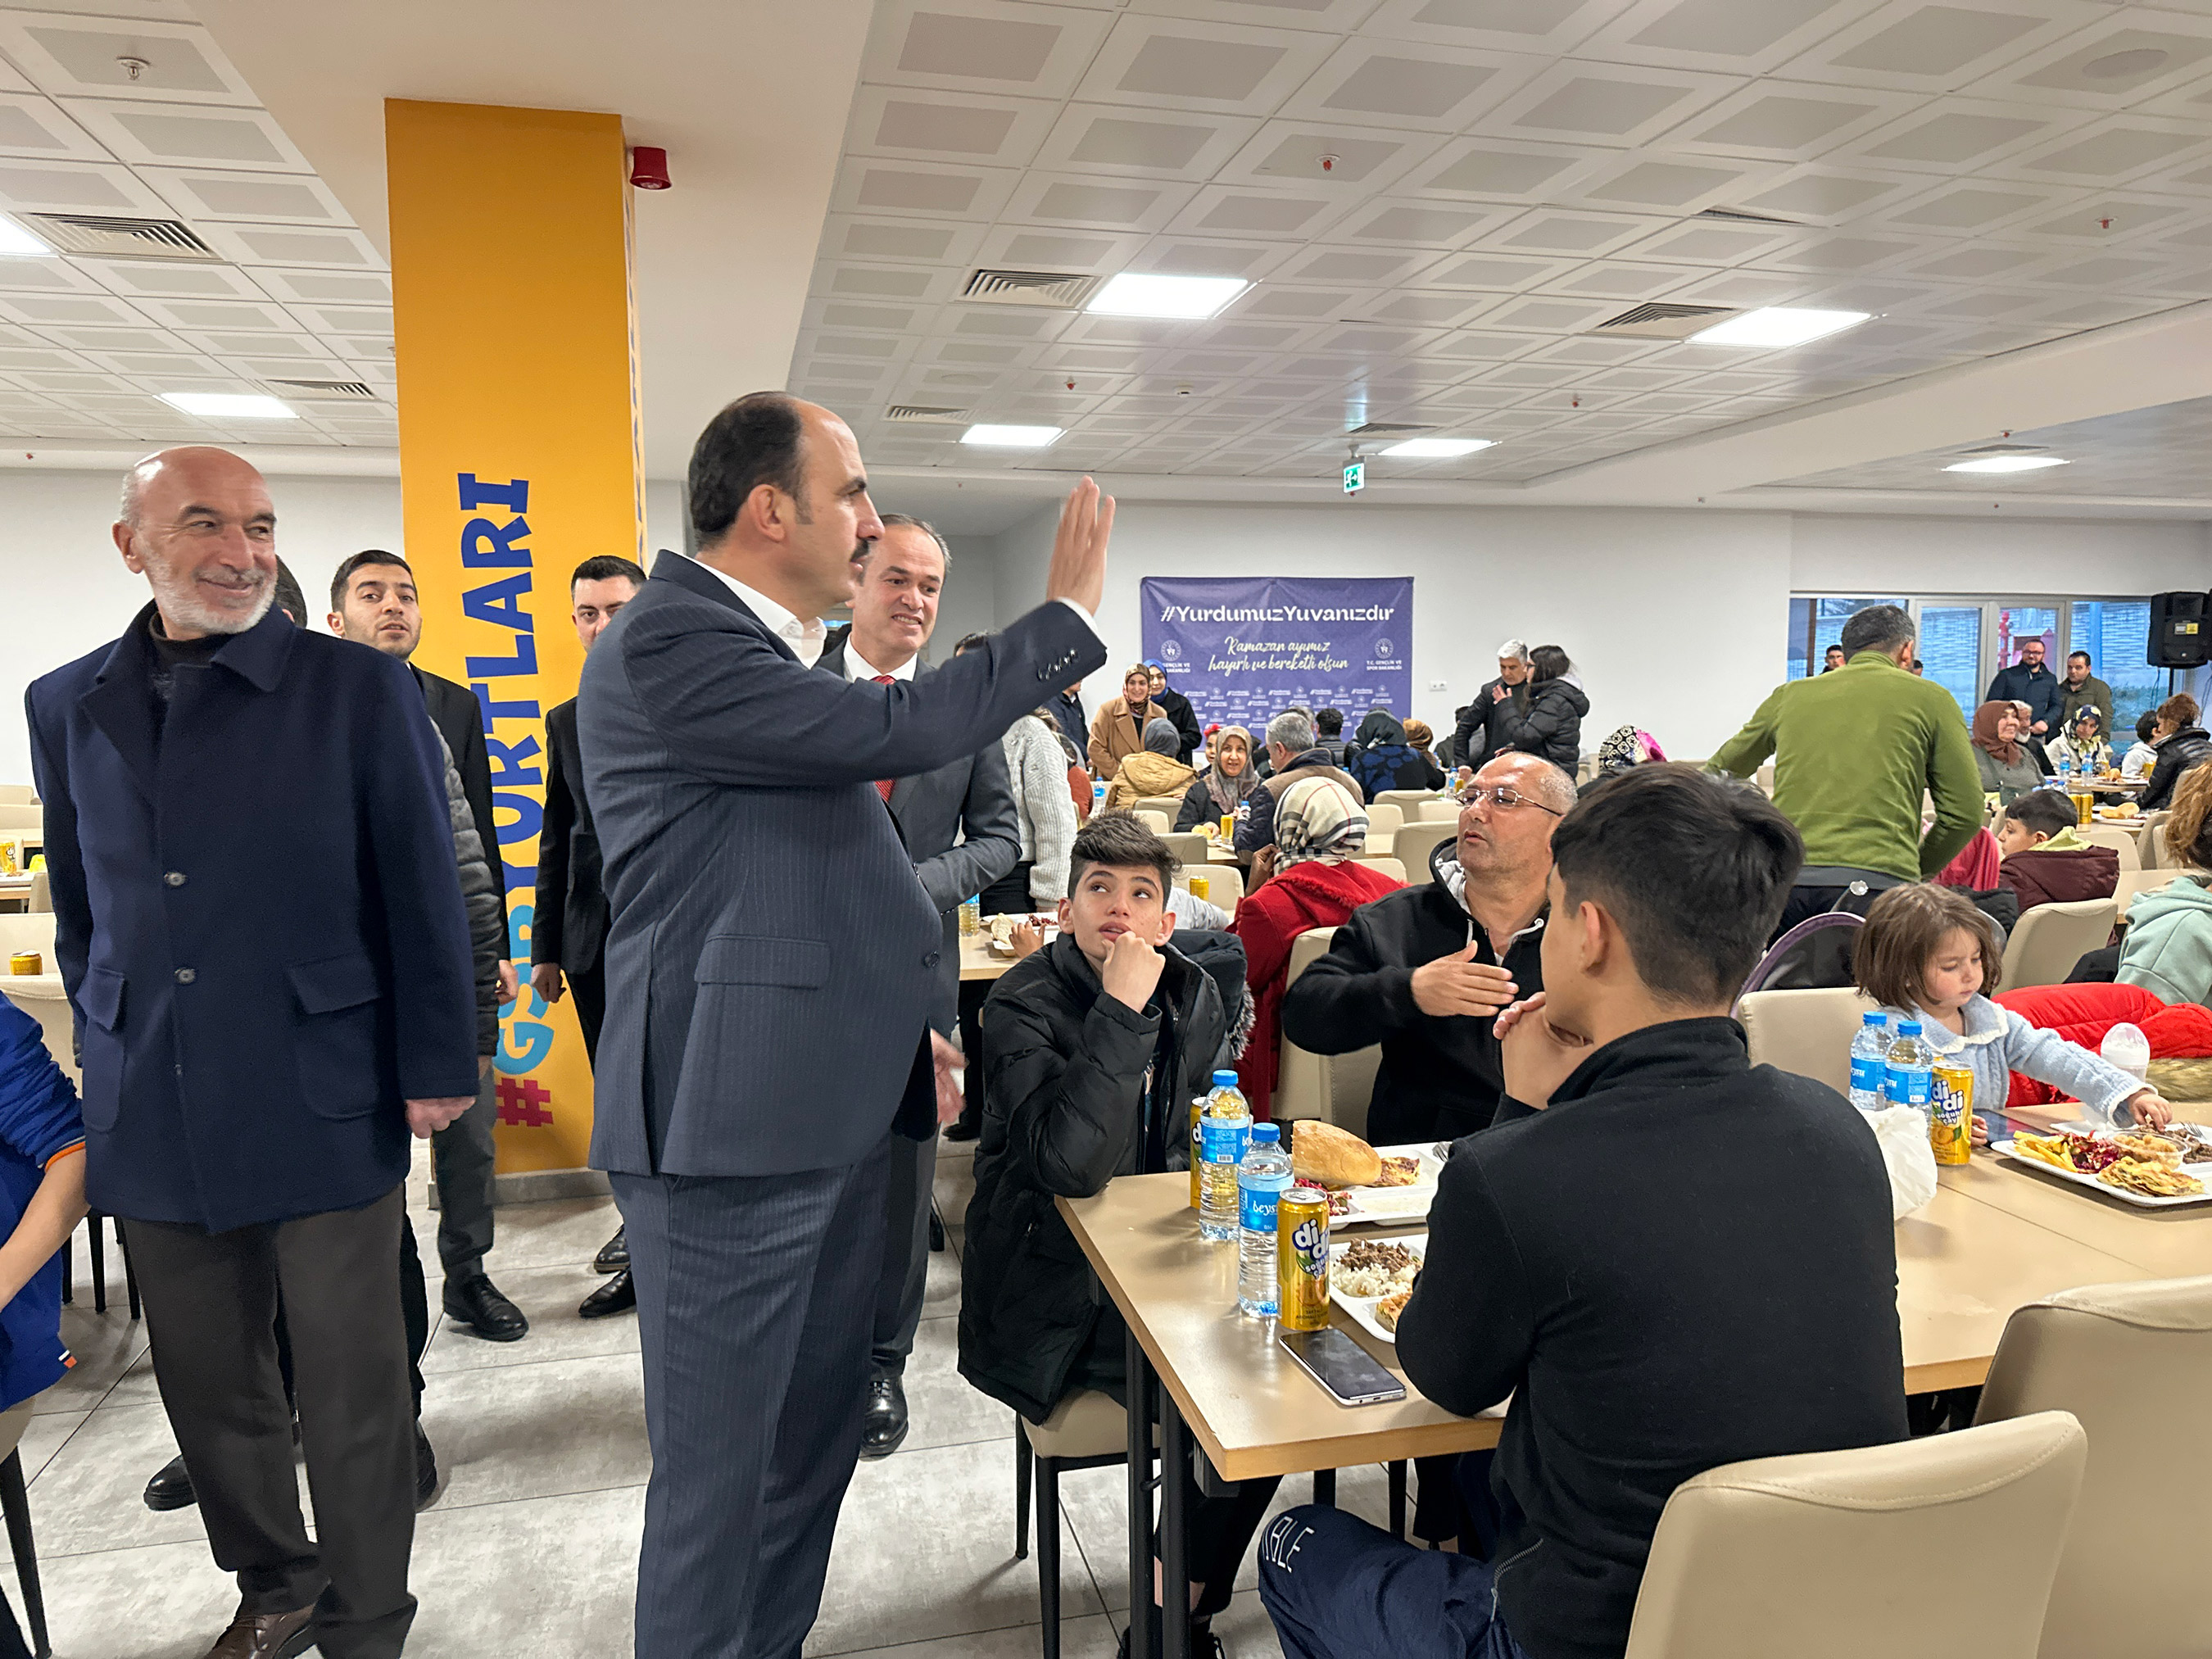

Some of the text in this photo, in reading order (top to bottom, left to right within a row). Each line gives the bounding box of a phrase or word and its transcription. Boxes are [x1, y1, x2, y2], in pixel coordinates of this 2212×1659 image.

[1160, 605, 1394, 623] #YurdumuzYuvanızdır
[1224, 636, 1331, 658] Ramazan ayımız
[1208, 654, 1349, 677] hayırlı ve bereketli olsun
[1932, 1080, 1949, 1100] di
[1942, 1090, 1965, 1112] di
[1253, 1199, 1278, 1217] beys
[1294, 1218, 1320, 1249] di
